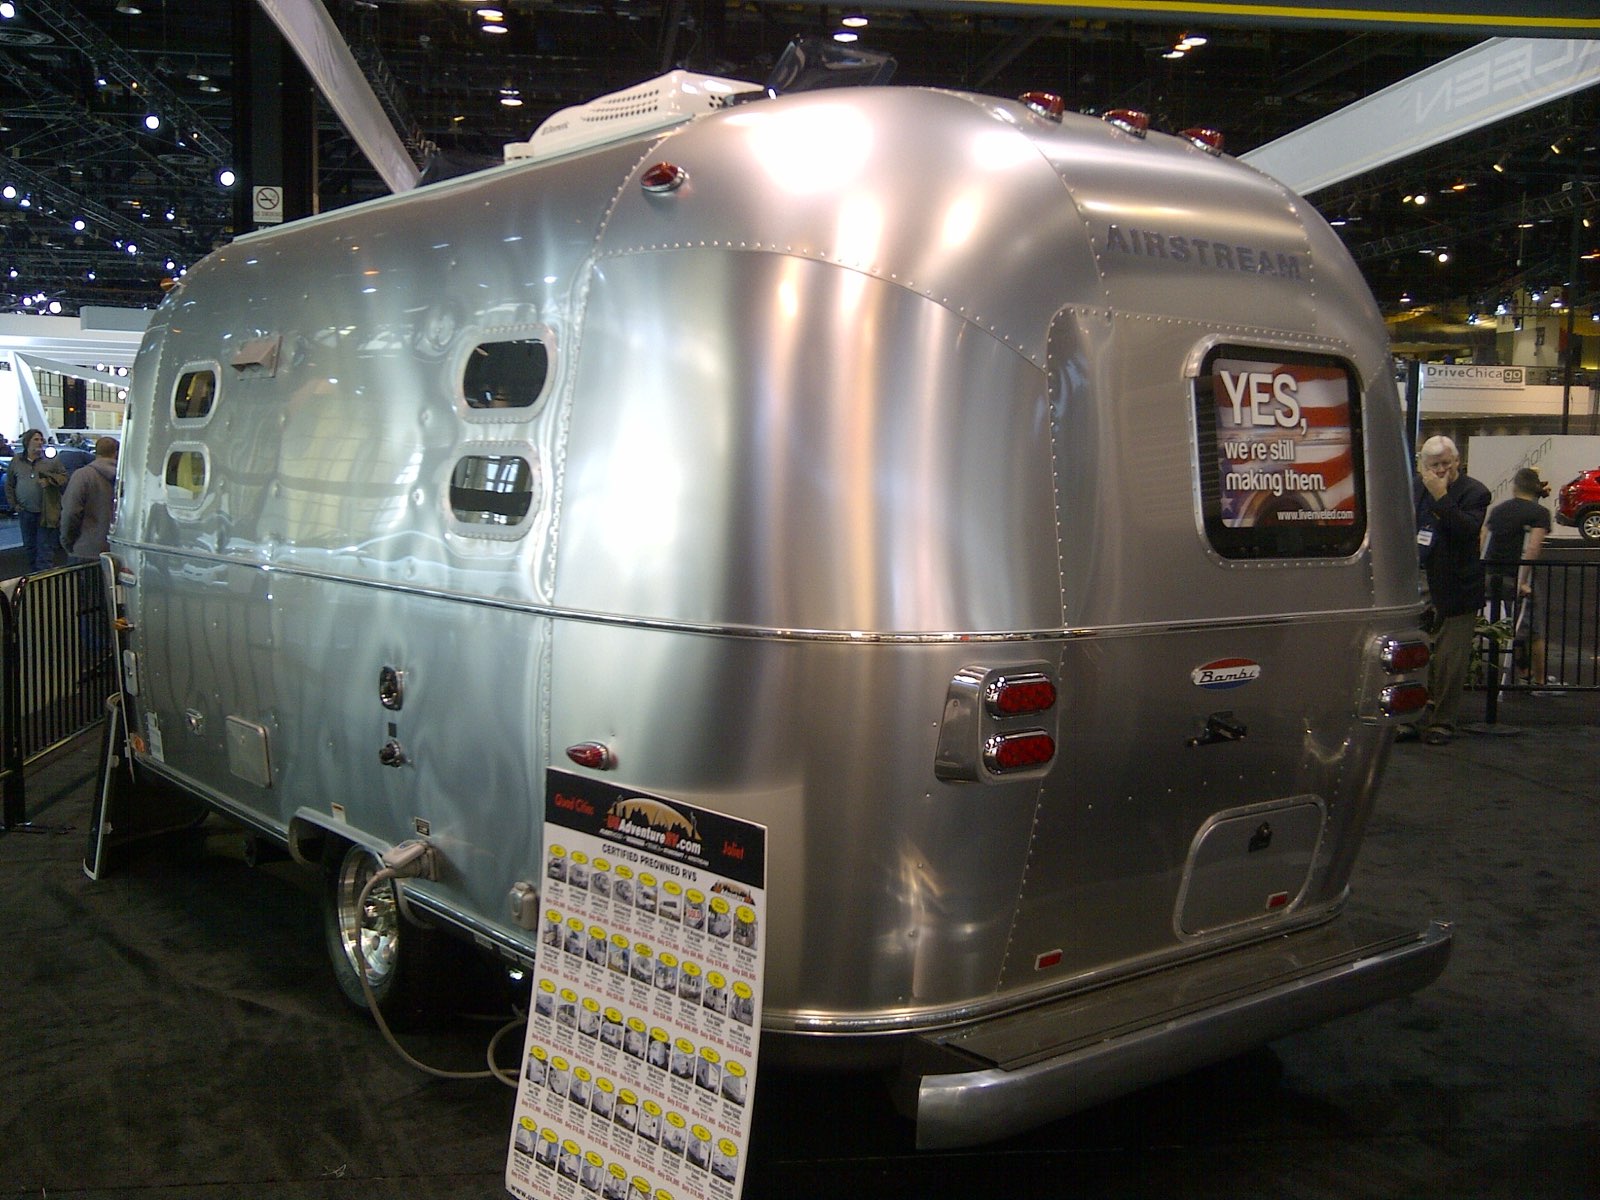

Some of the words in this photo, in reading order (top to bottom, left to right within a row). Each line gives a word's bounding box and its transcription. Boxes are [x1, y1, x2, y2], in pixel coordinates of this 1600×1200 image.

[1106, 224, 1301, 279] AIRSTREAM
[1220, 370, 1307, 435] YES,
[1271, 440, 1295, 461] still
[1226, 469, 1282, 497] making
[1285, 470, 1326, 491] them.
[1200, 669, 1256, 683] Bambi
[602, 843, 638, 862] CERTIFIED
[640, 855, 680, 876] PREOWNED
[682, 867, 697, 882] RVS
